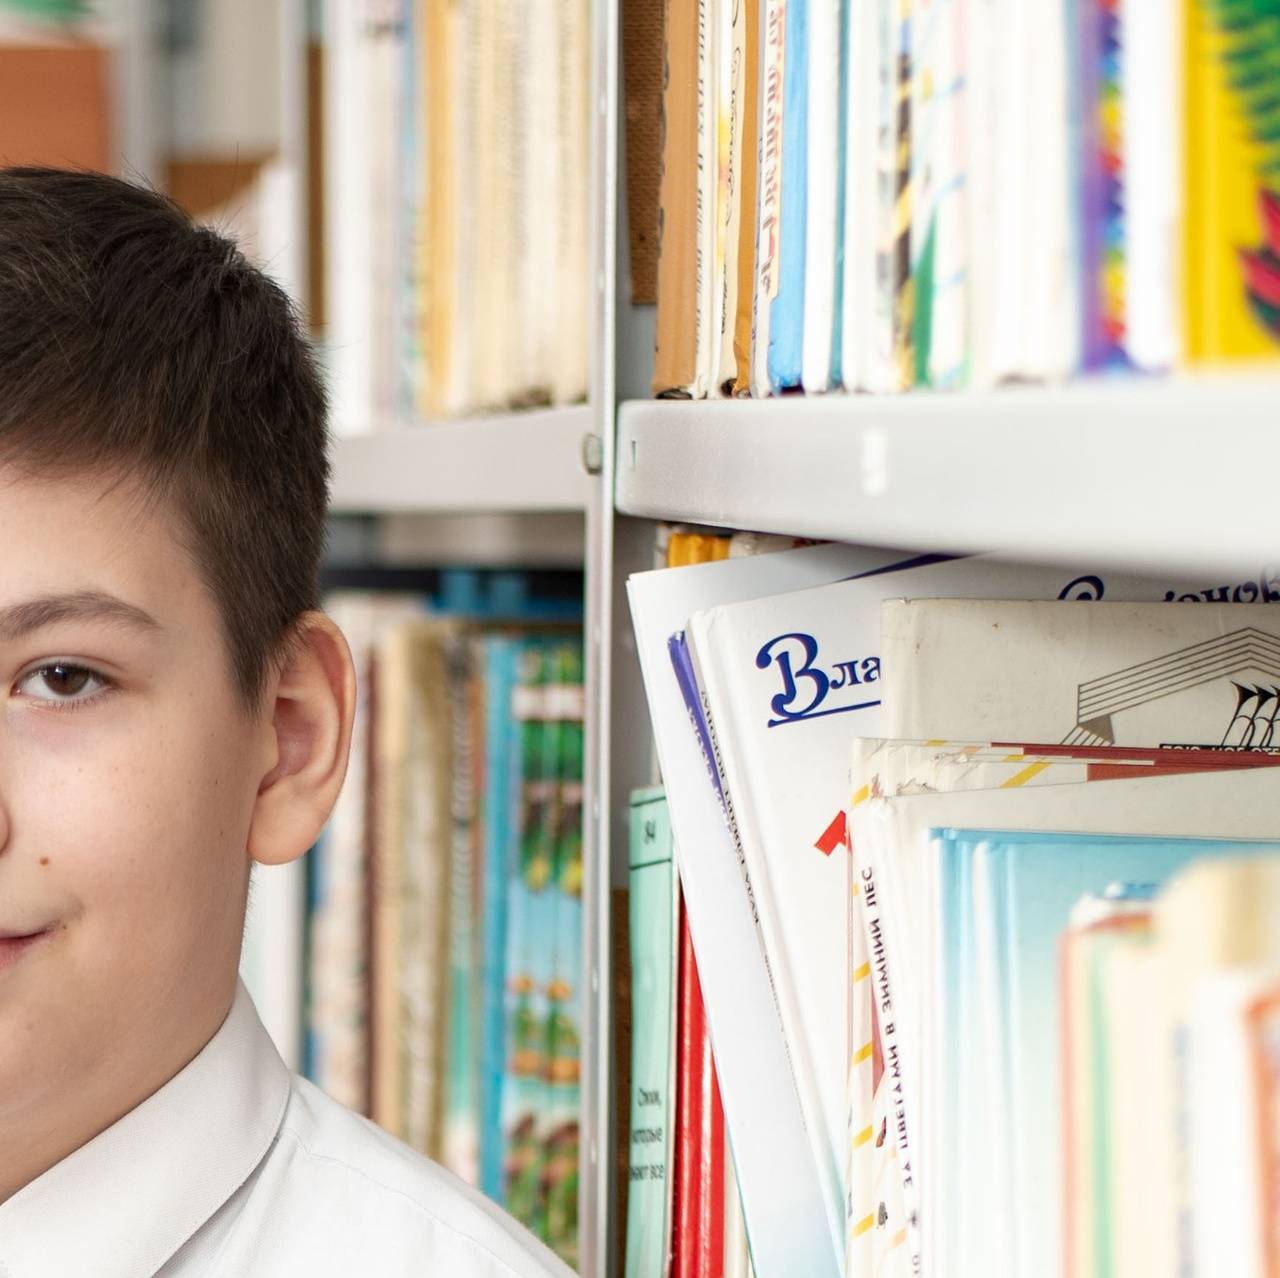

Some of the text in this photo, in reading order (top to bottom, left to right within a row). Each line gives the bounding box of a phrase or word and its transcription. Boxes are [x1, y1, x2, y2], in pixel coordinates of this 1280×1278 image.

[861, 866, 913, 1190] ЗА ЦВЕТАМИ В ЗИМНИЙ ЛЕС
